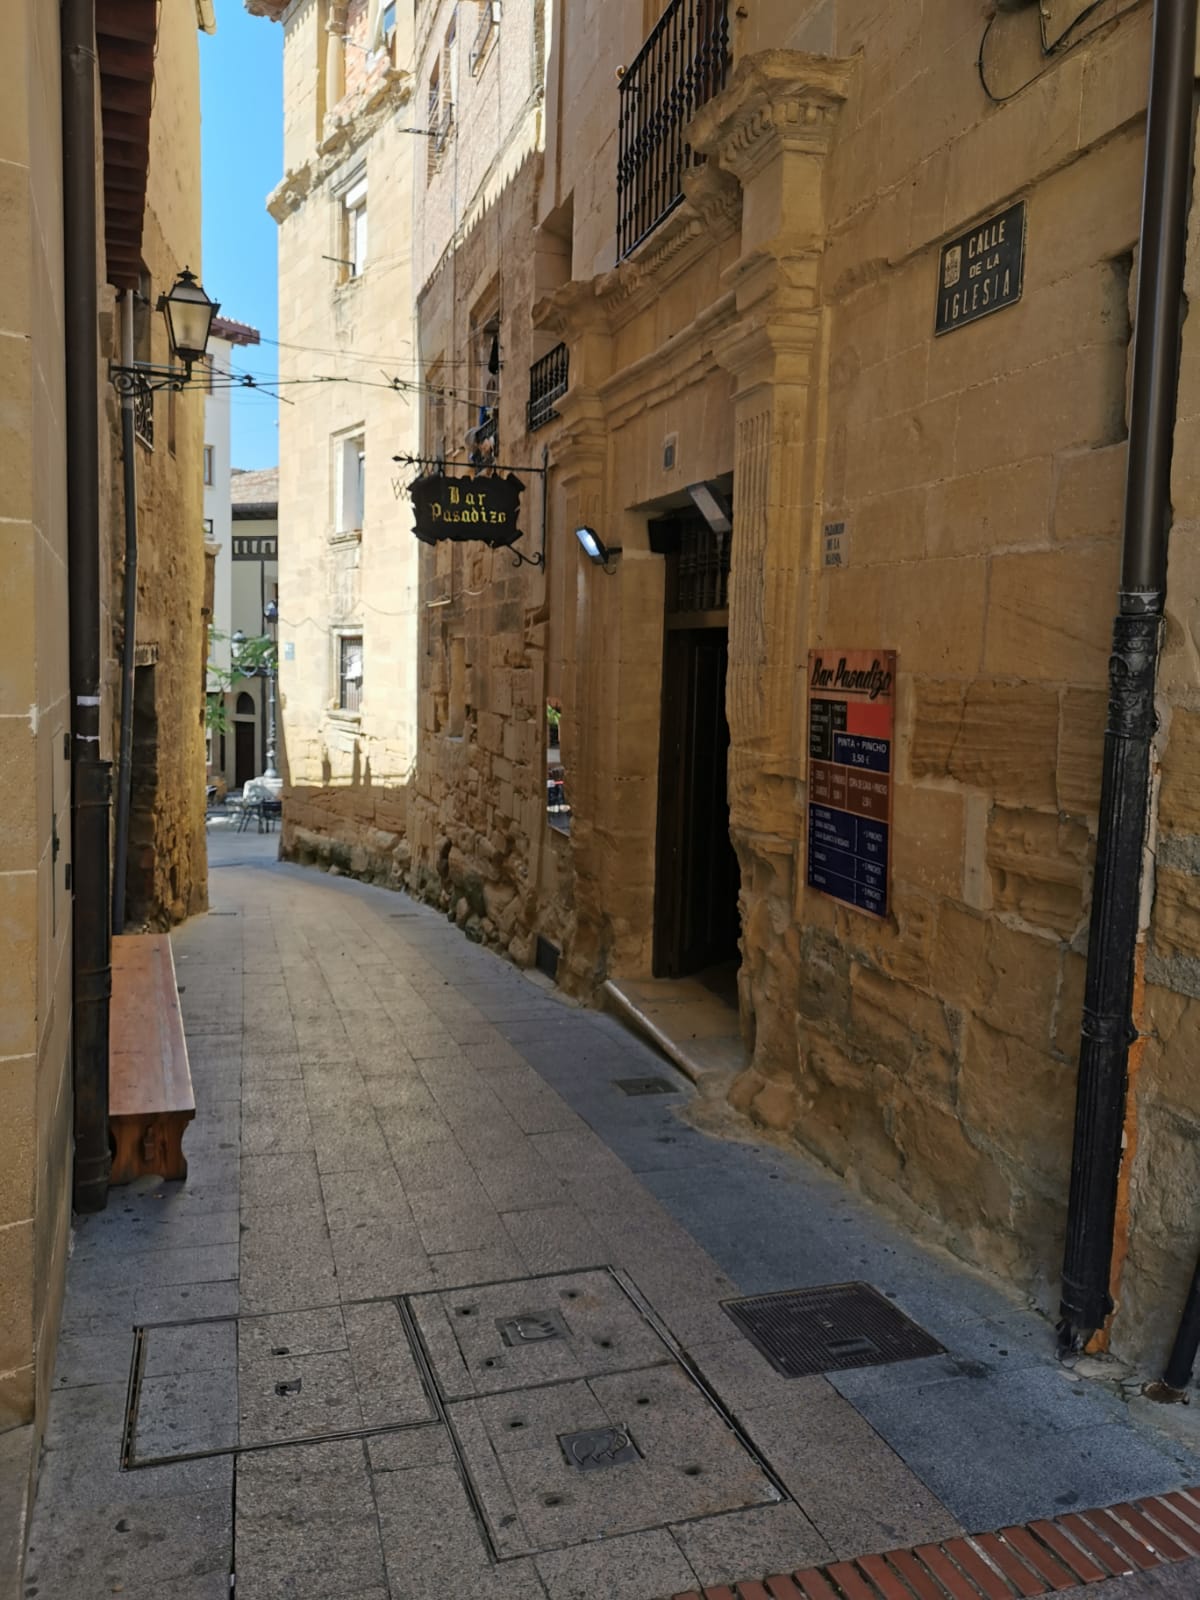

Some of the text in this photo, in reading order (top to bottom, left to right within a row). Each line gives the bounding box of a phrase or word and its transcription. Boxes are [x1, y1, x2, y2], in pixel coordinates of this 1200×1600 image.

[968, 220, 1006, 259] CALLE
[968, 253, 1000, 279] DE LA
[944, 269, 1010, 322] IGLESIA
[448, 486, 486, 506] Bar
[431, 503, 507, 524] Pasadizo
[811, 657, 892, 700] Bar Pasadizo
[837, 737, 855, 748] PINTA
[861, 741, 887, 753] PINCHO
